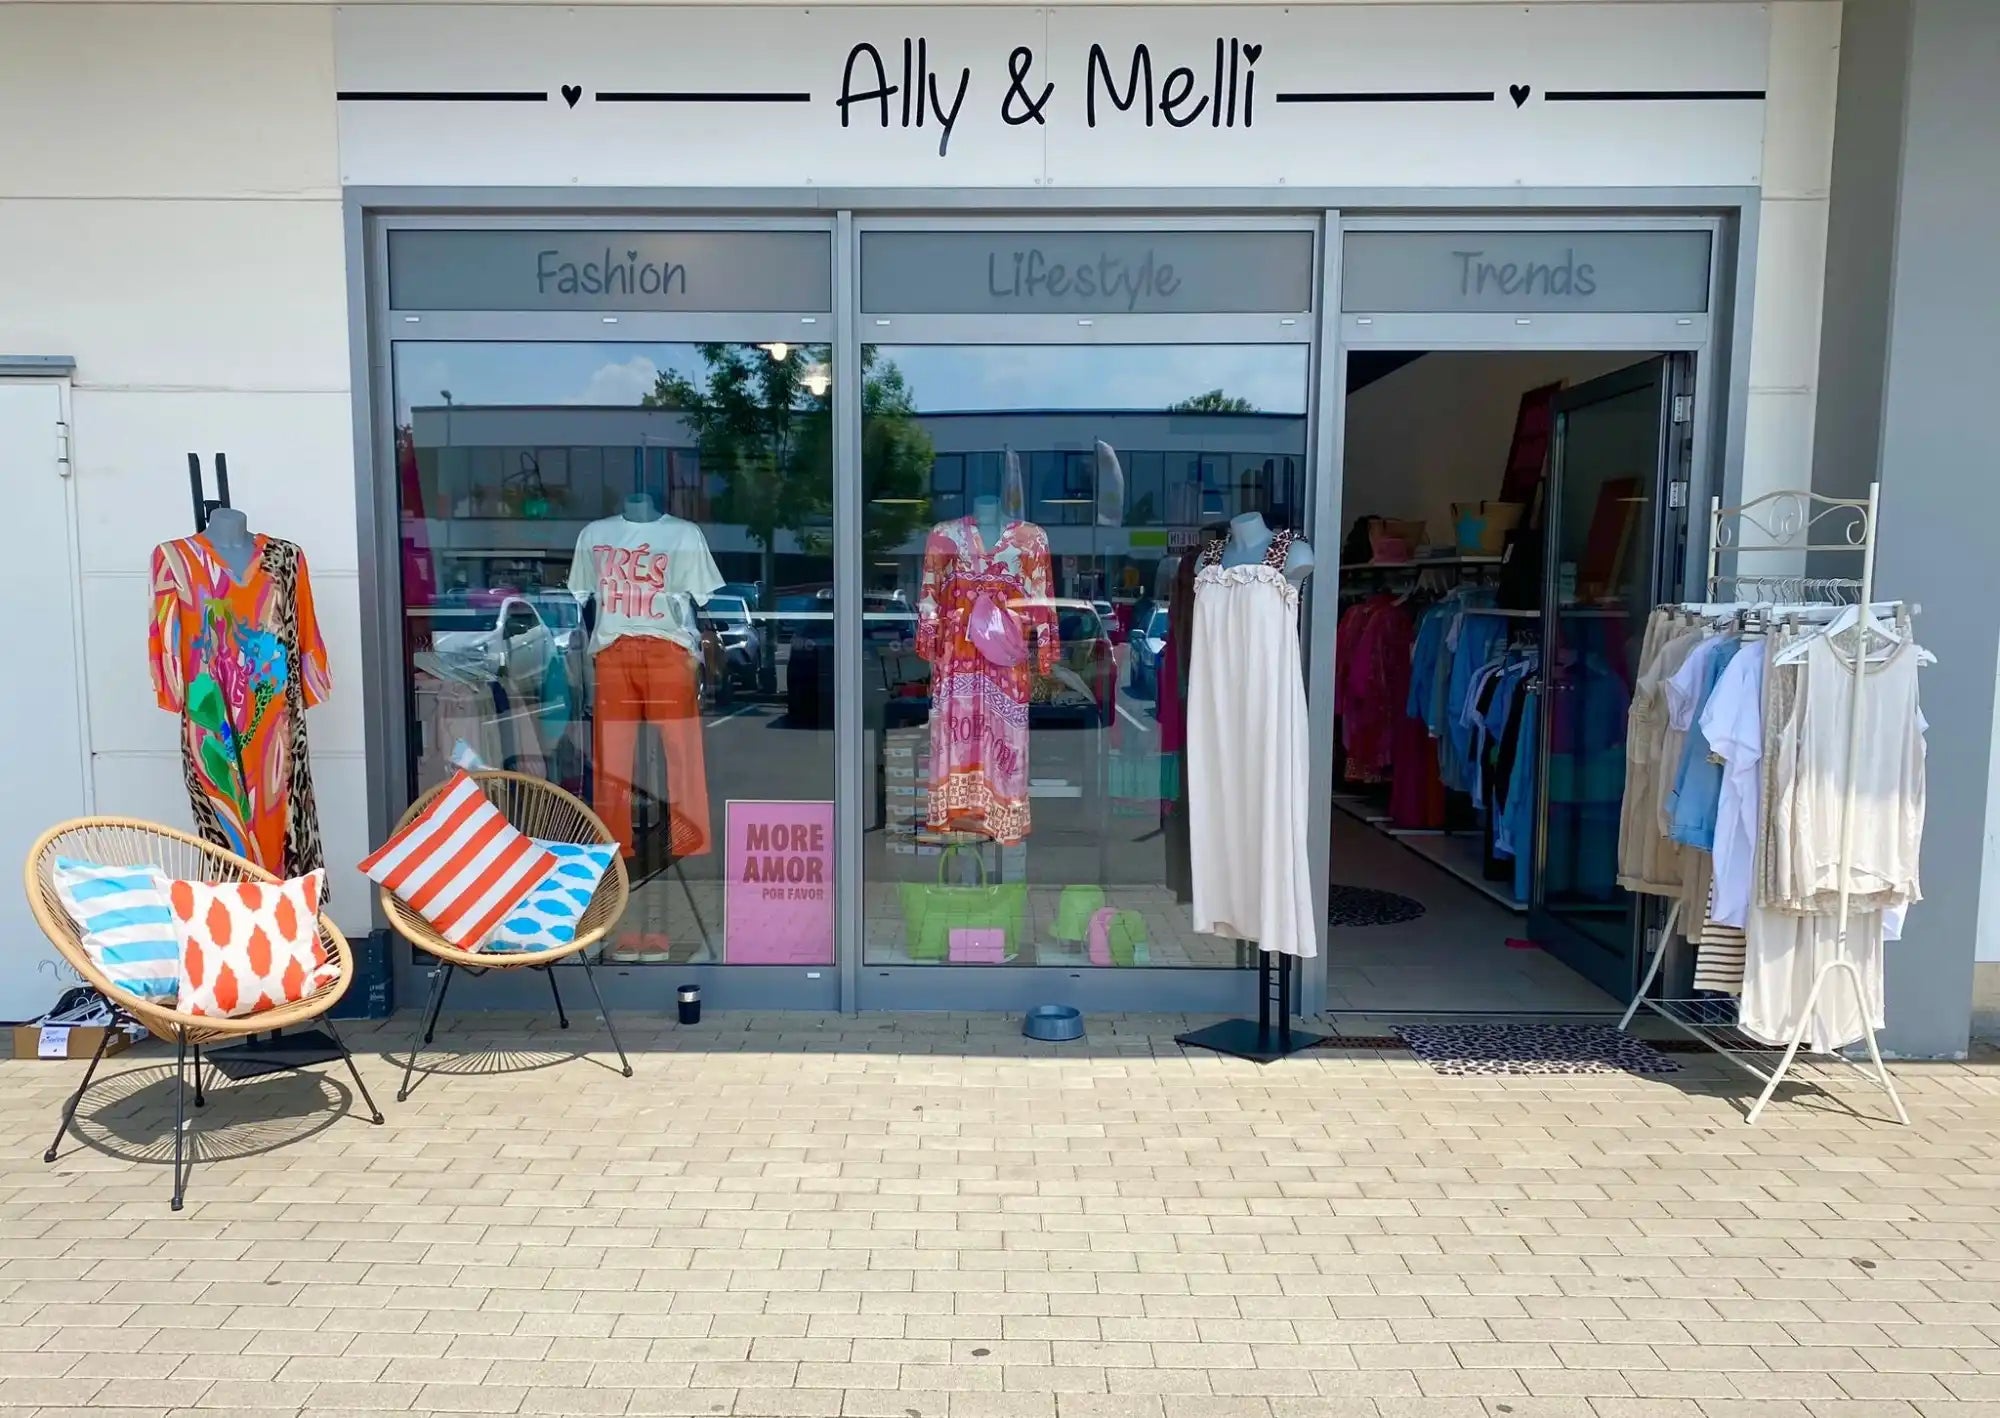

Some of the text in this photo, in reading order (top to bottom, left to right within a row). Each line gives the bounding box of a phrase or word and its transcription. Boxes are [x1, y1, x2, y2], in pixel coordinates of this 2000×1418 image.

[836, 37, 1263, 157] Ally & Melli
[536, 246, 687, 296] Fashion
[988, 249, 1182, 312] Lifestyle
[1452, 248, 1597, 296] Trends
[746, 823, 824, 852] MORE
[742, 856, 824, 884] AMOR
[762, 887, 824, 900] POR FAVOR
